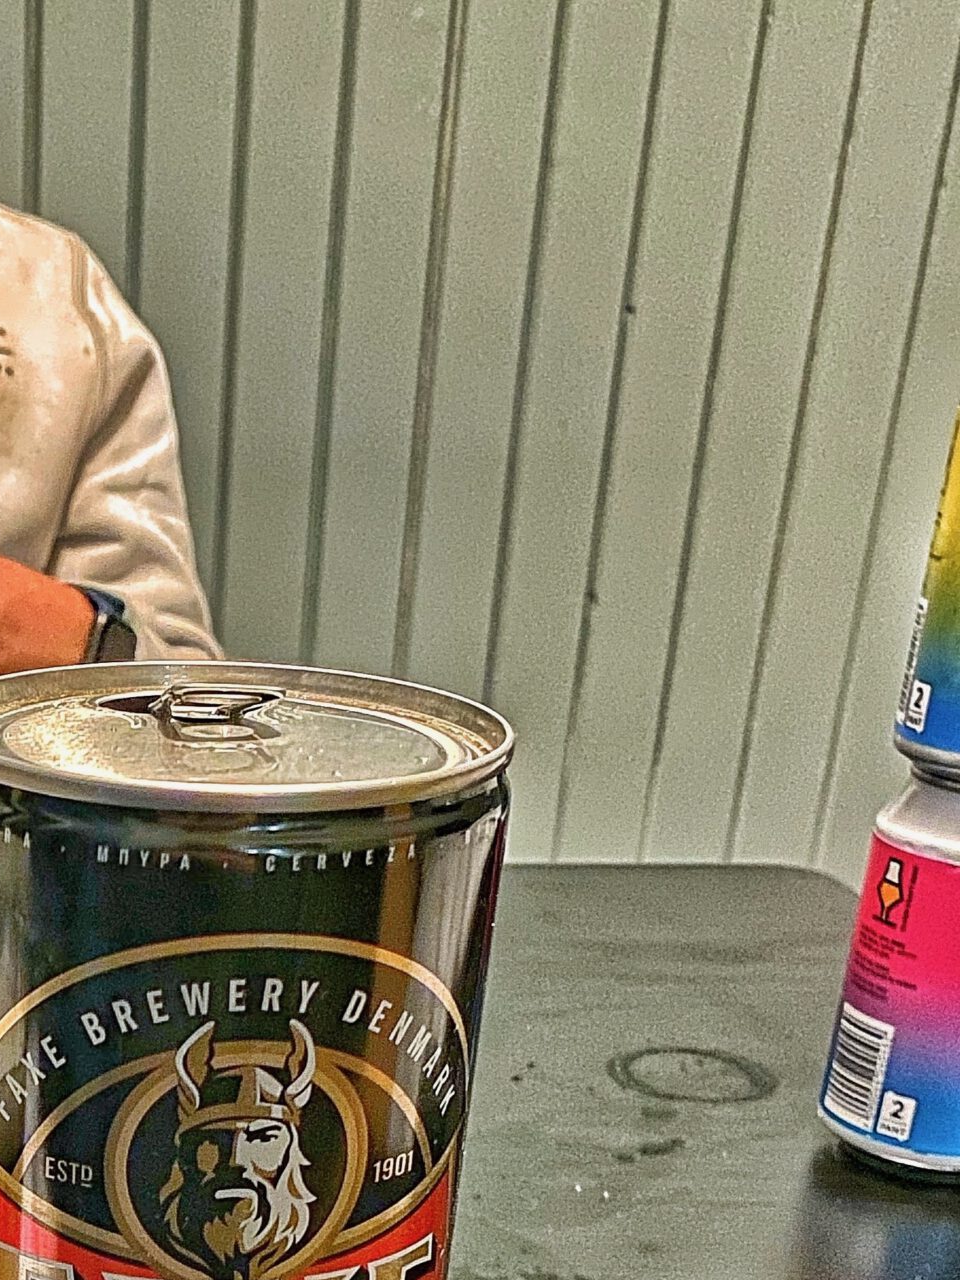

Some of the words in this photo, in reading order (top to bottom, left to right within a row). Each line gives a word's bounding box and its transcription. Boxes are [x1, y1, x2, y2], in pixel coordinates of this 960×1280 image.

[265, 843, 416, 873] CERVEZA
[80, 978, 319, 1046] BREWERY
[343, 989, 456, 1117] DENMARK
[890, 1099, 905, 1119] 2
[44, 1156, 94, 1188] ESTD
[372, 1150, 414, 1184] 1901
